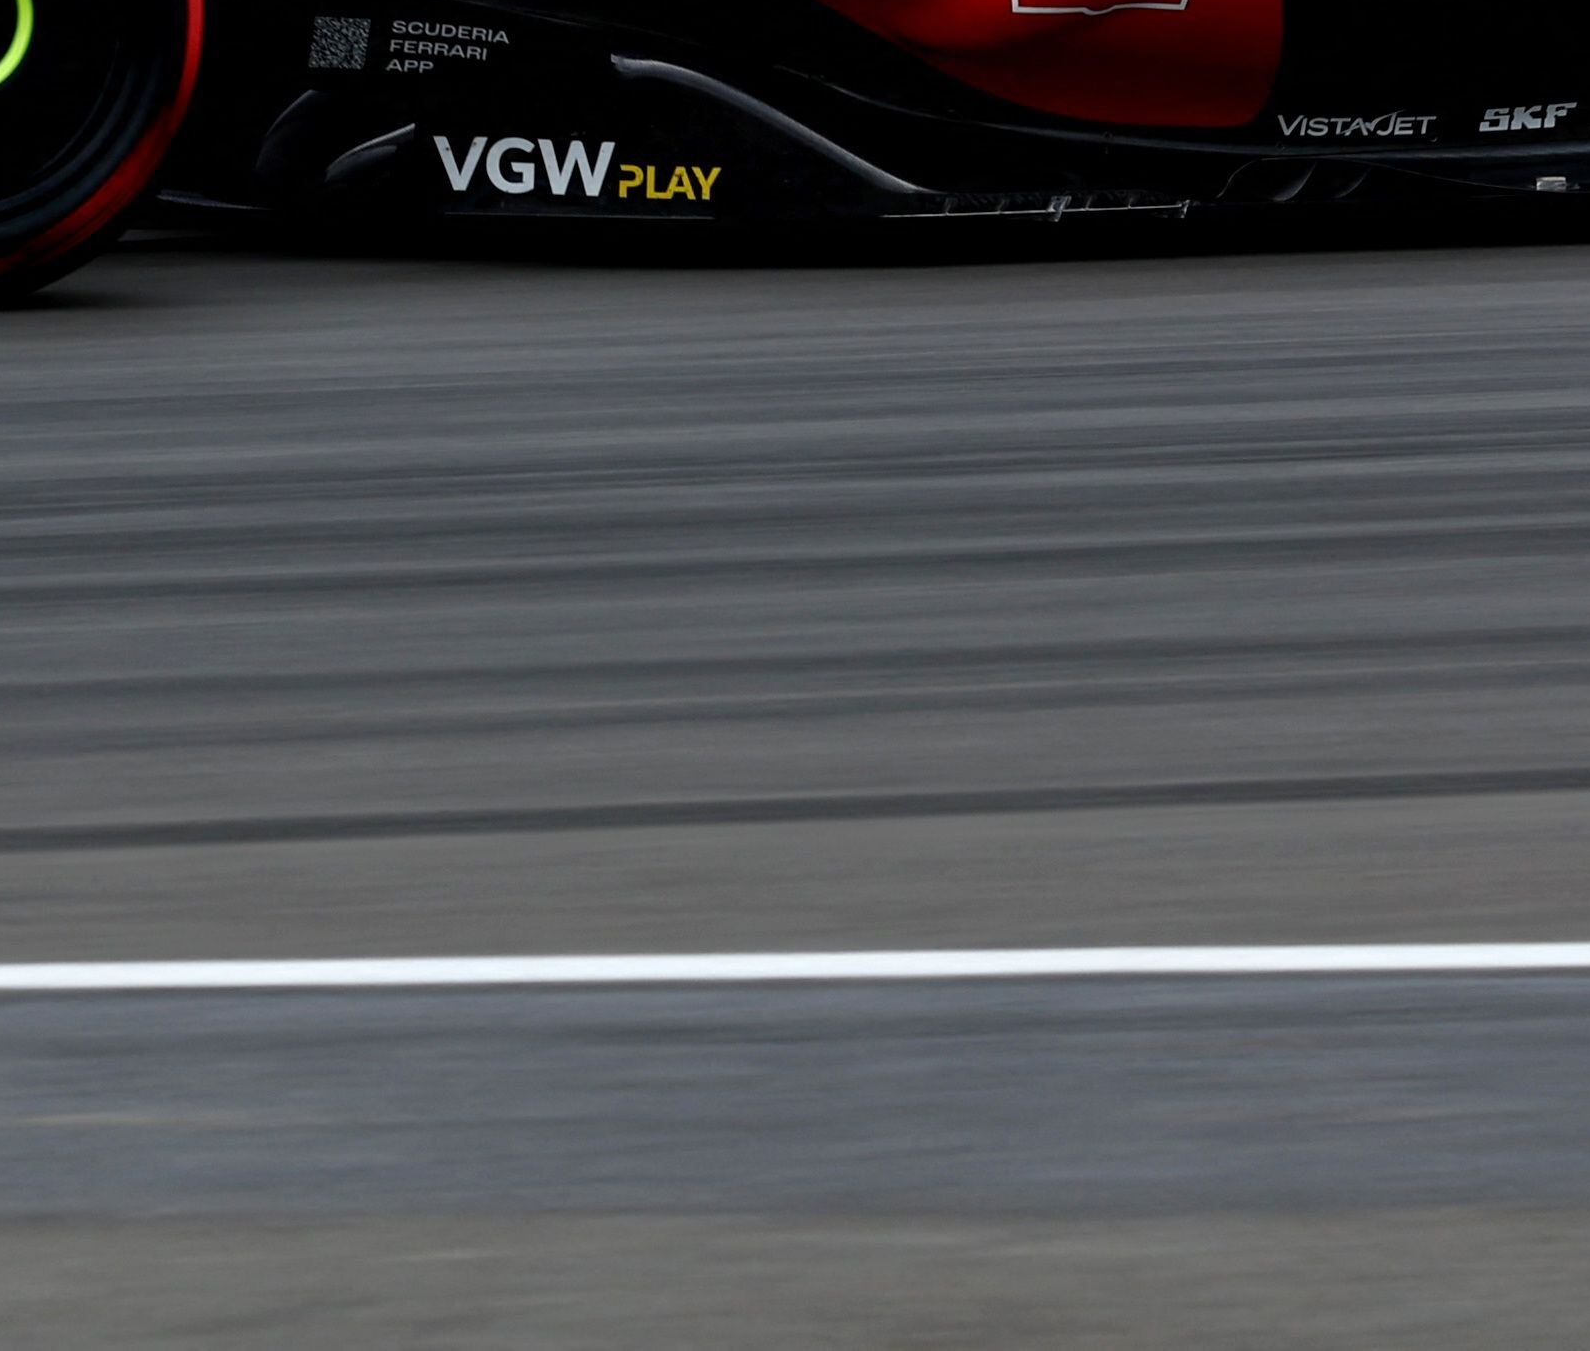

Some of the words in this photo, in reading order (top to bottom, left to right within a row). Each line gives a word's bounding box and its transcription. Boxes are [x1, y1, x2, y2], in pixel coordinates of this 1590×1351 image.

[390, 19, 511, 46] SCUDERIA
[387, 39, 489, 62] FERRARI
[384, 58, 436, 75] APP
[1477, 101, 1578, 133] SKF
[433, 135, 617, 199] VGW
[617, 164, 724, 201] PLAY
